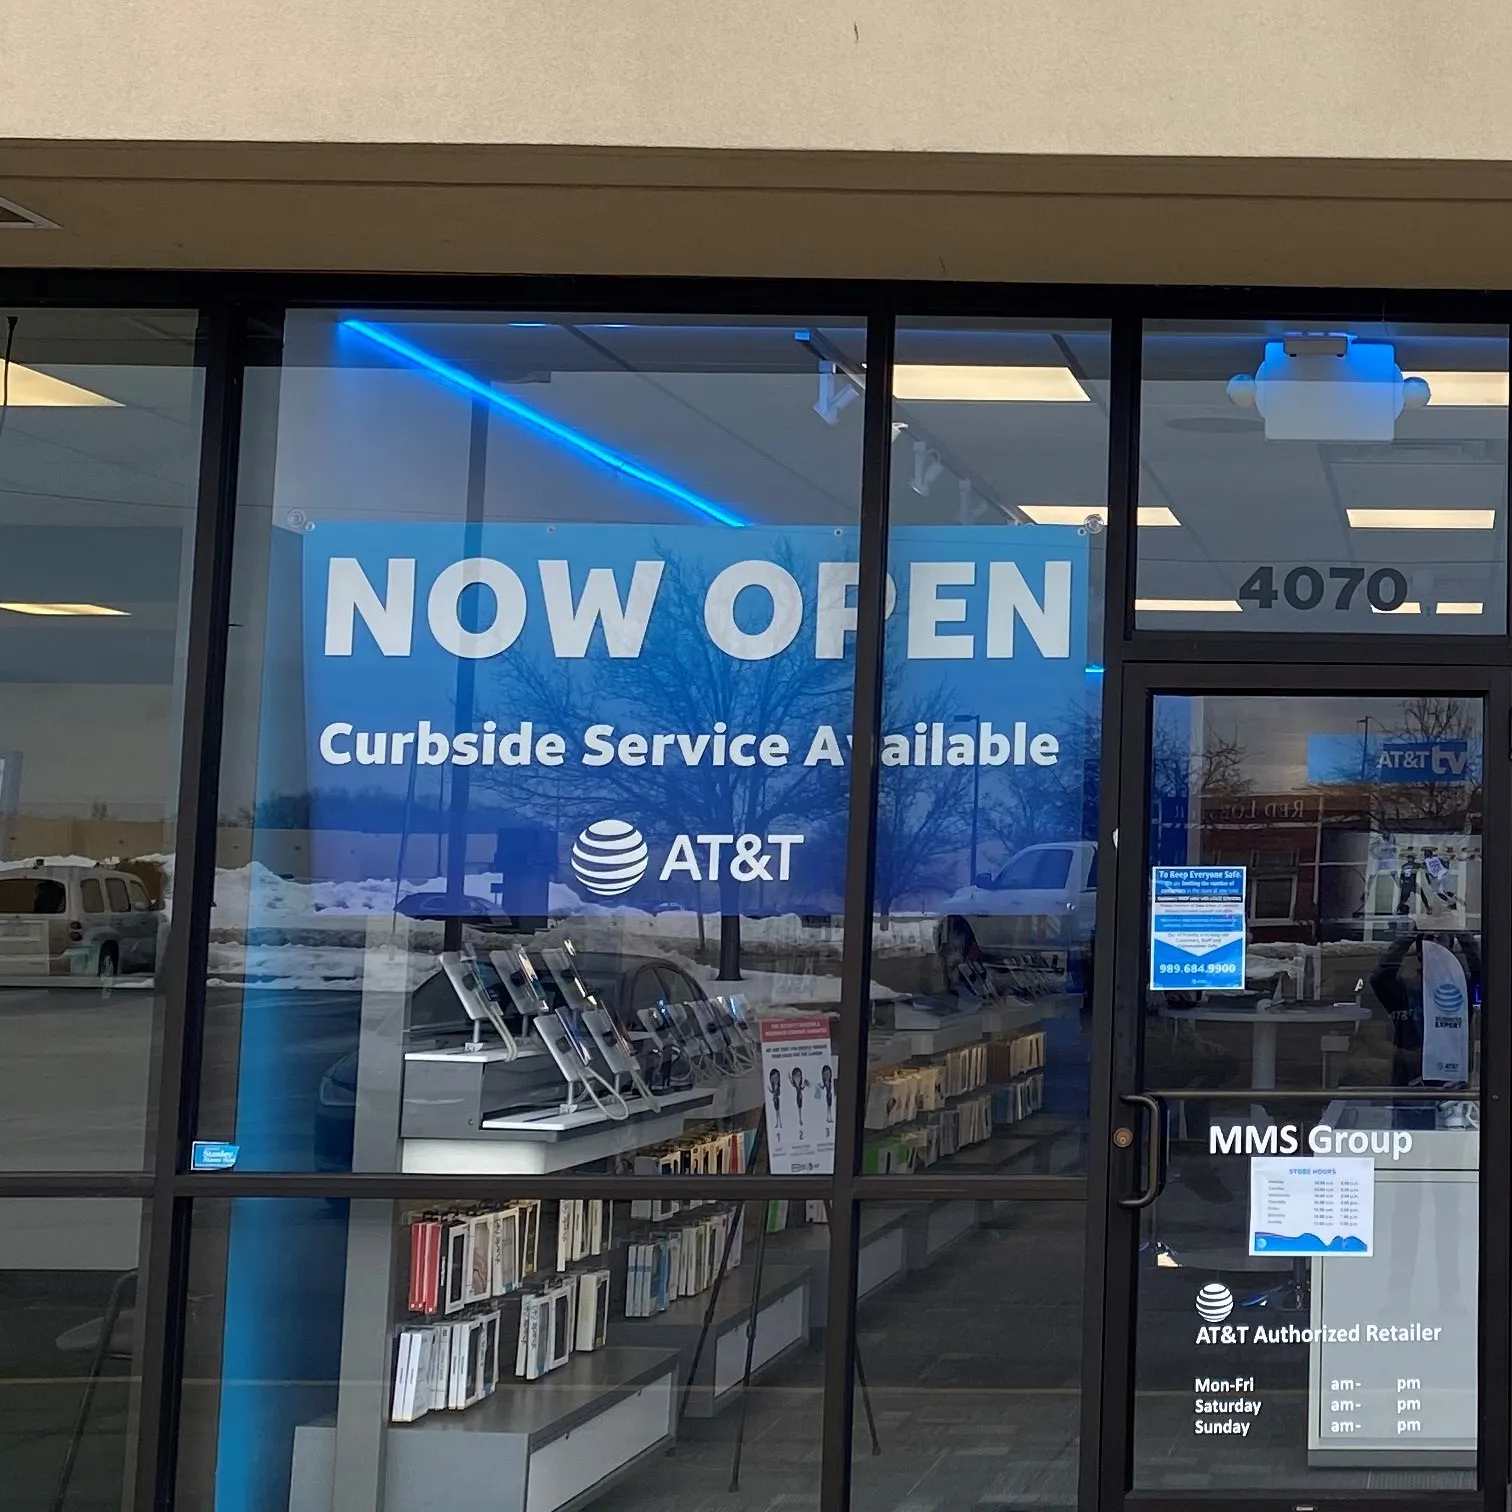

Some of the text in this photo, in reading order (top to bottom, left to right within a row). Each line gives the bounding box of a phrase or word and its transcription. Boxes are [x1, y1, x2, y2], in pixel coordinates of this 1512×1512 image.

[1238, 565, 1409, 612] 4070
[324, 557, 1072, 660] NOW OPEN
[319, 720, 1060, 768] Curbside Service Aailable
[1376, 744, 1467, 775] AT&T tv
[659, 833, 805, 882] AT&T
[1158, 870, 1169, 879] To
[1170, 870, 1189, 880] Keep
[1189, 870, 1223, 880] Everyone
[1159, 963, 1236, 974] 989.684.9900
[1209, 1124, 1413, 1161] MMS Group
[1195, 1322, 1443, 1345] AT&T Authorized Retailer
[1194, 1376, 1254, 1393] Mon-Fri
[1396, 1377, 1422, 1393] pm
[1194, 1397, 1262, 1416] Saturday
[1396, 1398, 1422, 1414] pm
[1194, 1418, 1251, 1436] Sunday
[1396, 1418, 1422, 1434] pm
